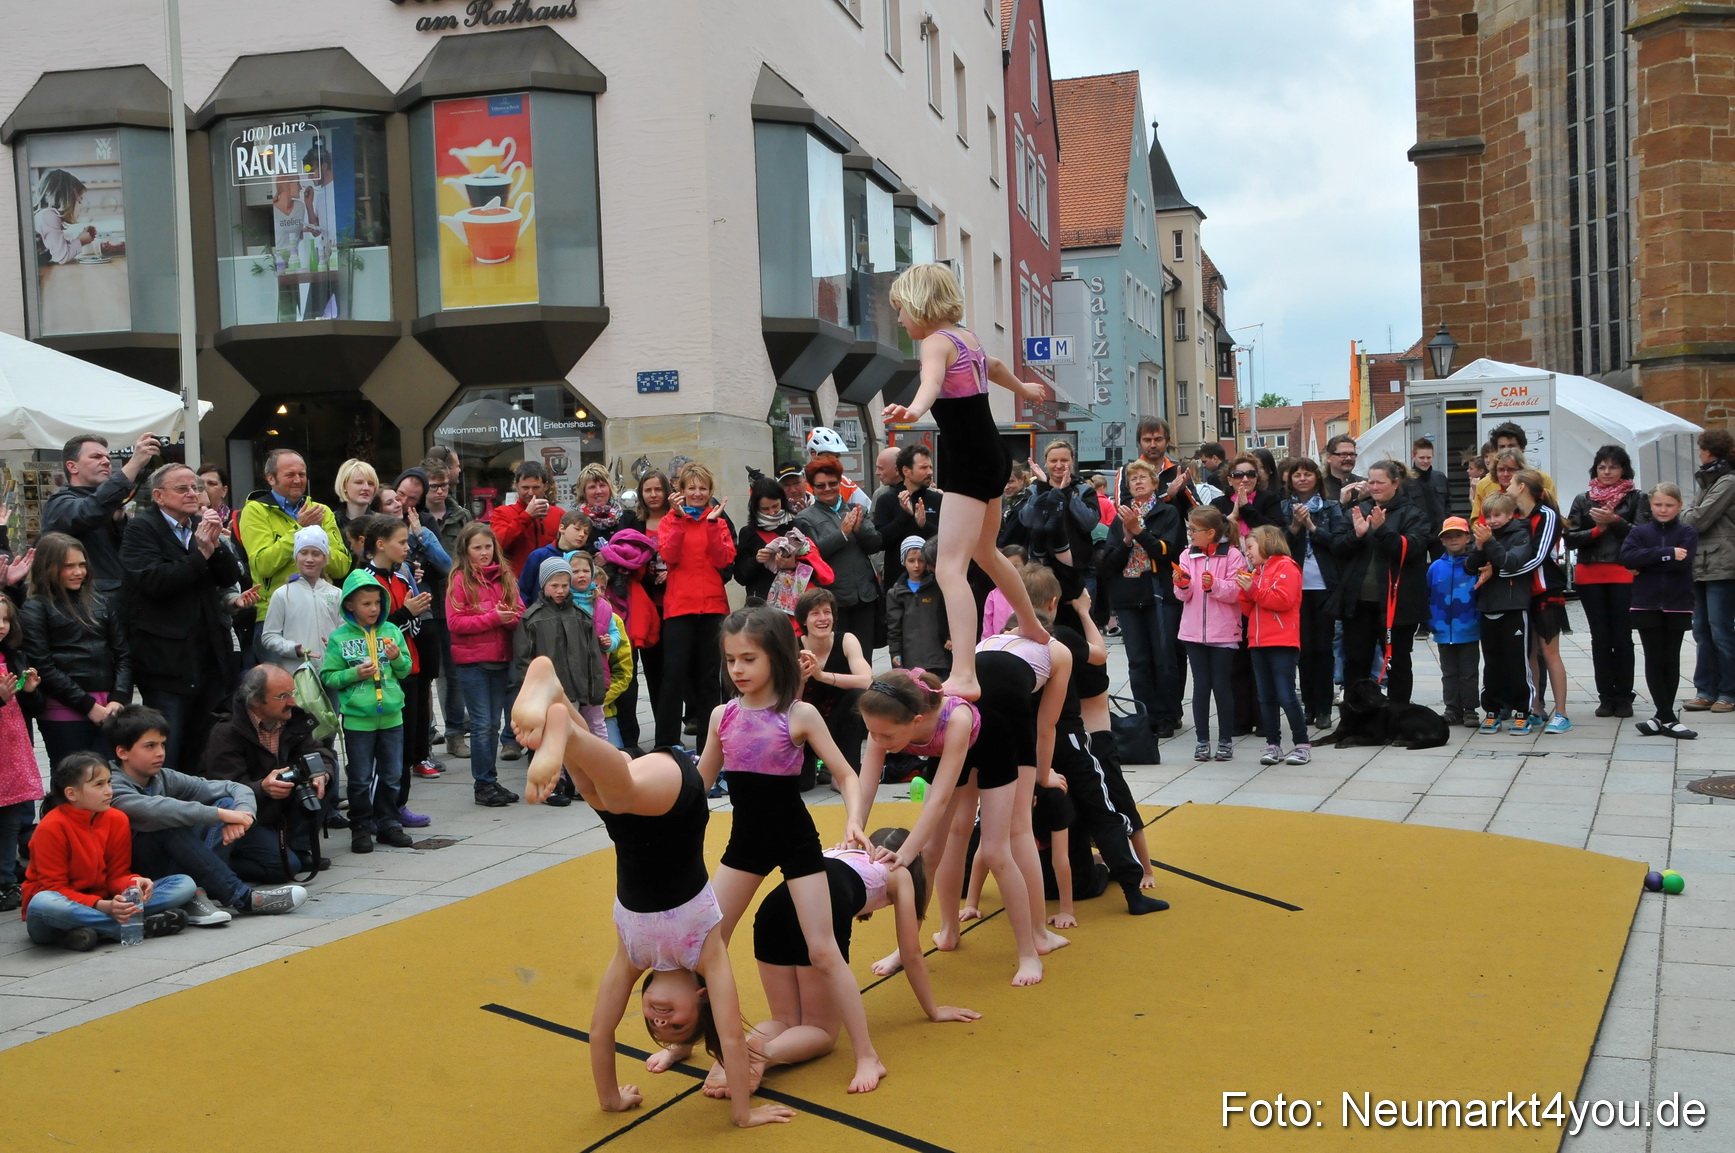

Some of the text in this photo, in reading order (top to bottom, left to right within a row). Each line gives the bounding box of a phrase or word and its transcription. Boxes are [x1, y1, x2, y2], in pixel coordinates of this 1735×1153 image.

[415, 0, 578, 32] am Rathaus
[241, 121, 306, 144] 100 Jahre
[236, 143, 298, 177] RACKL
[280, 217, 302, 227] atelier
[1034, 341, 1043, 357] C
[1056, 340, 1068, 356] M
[1500, 386, 1528, 397] CAH
[1489, 397, 1539, 409] Spülmobil
[439, 425, 487, 435] Willkommen
[488, 424, 498, 433] im
[500, 416, 541, 438] RACKL
[543, 420, 596, 430] Erlebnishaus.
